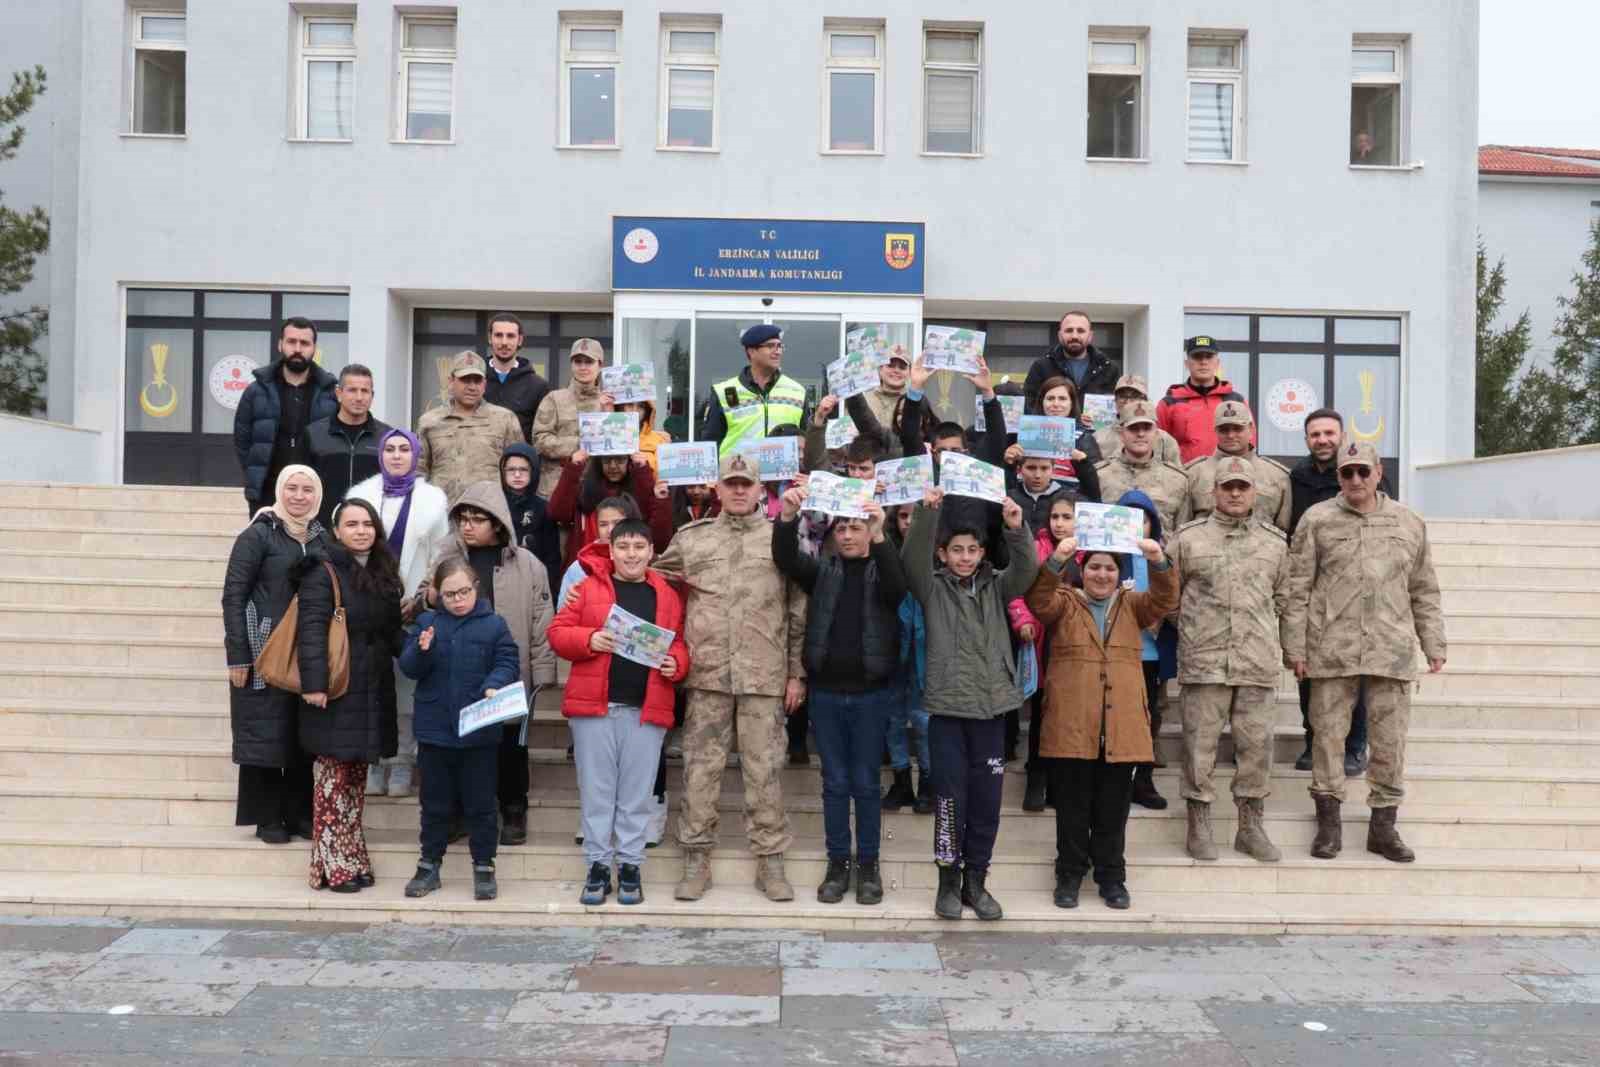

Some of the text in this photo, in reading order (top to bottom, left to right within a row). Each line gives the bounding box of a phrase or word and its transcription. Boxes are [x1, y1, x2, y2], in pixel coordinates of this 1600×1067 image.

[718, 247, 770, 259] ERZİNCAN
[693, 266, 705, 278] İL
[708, 267, 765, 279] JANDARMA
